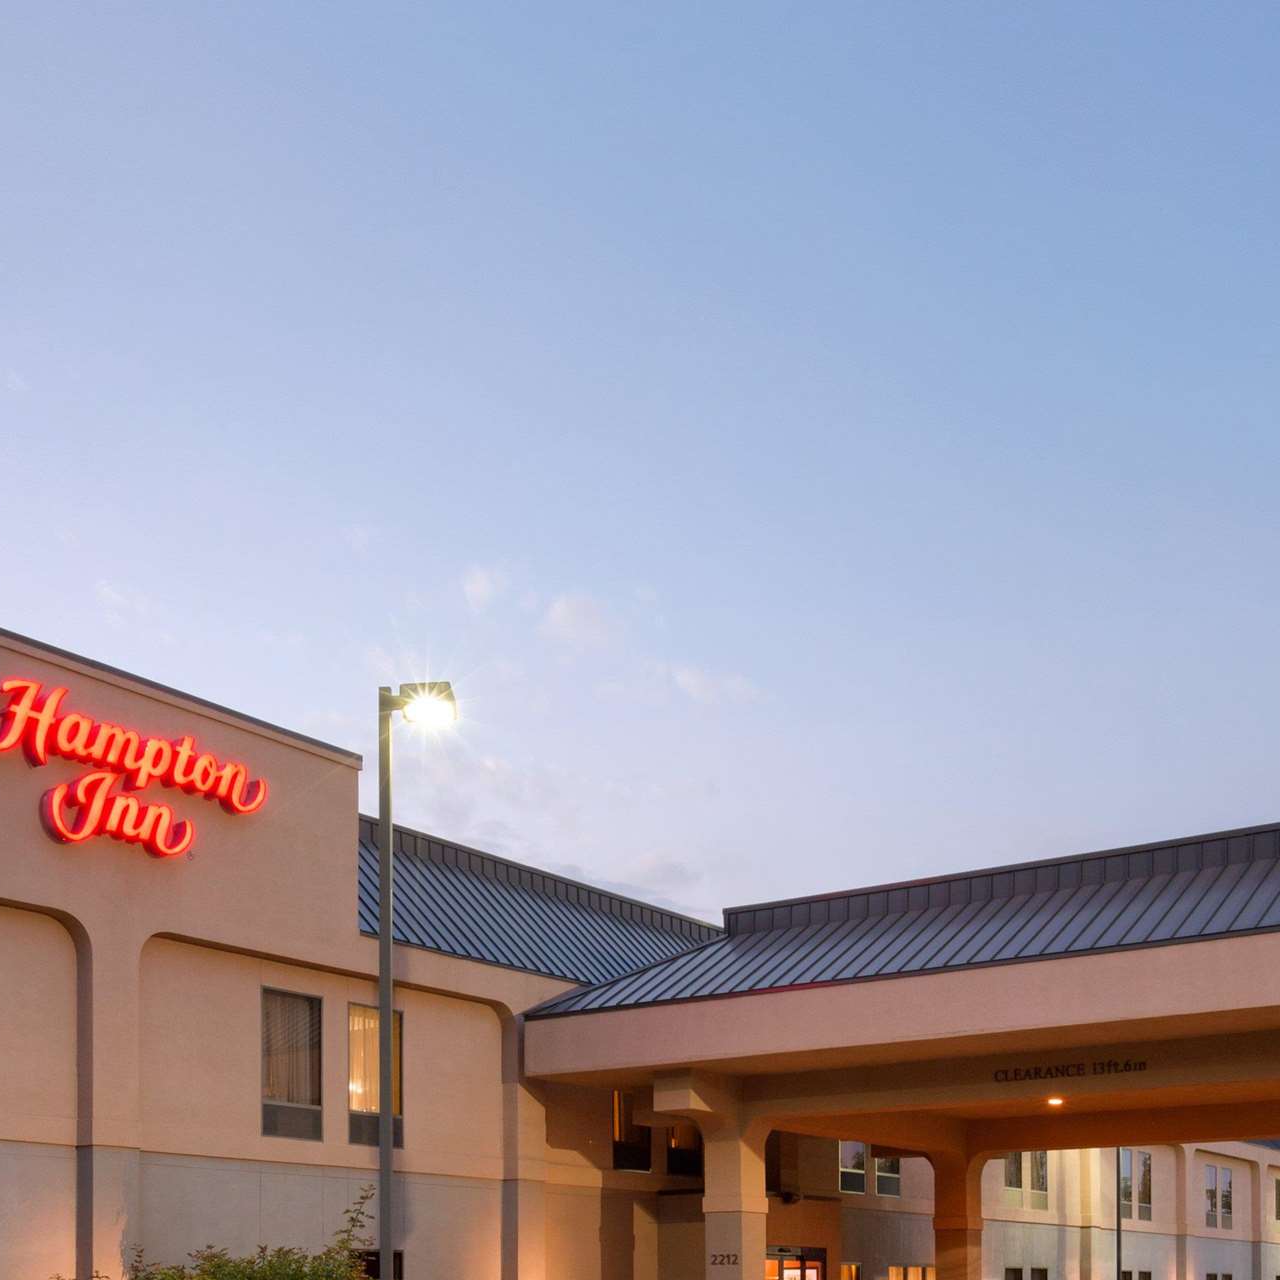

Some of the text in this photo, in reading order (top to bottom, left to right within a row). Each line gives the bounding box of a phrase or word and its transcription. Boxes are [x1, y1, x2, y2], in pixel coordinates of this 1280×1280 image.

[41, 771, 194, 857] Inn
[993, 1063, 1086, 1082] CLEARANCE
[711, 1254, 739, 1266] 2212
